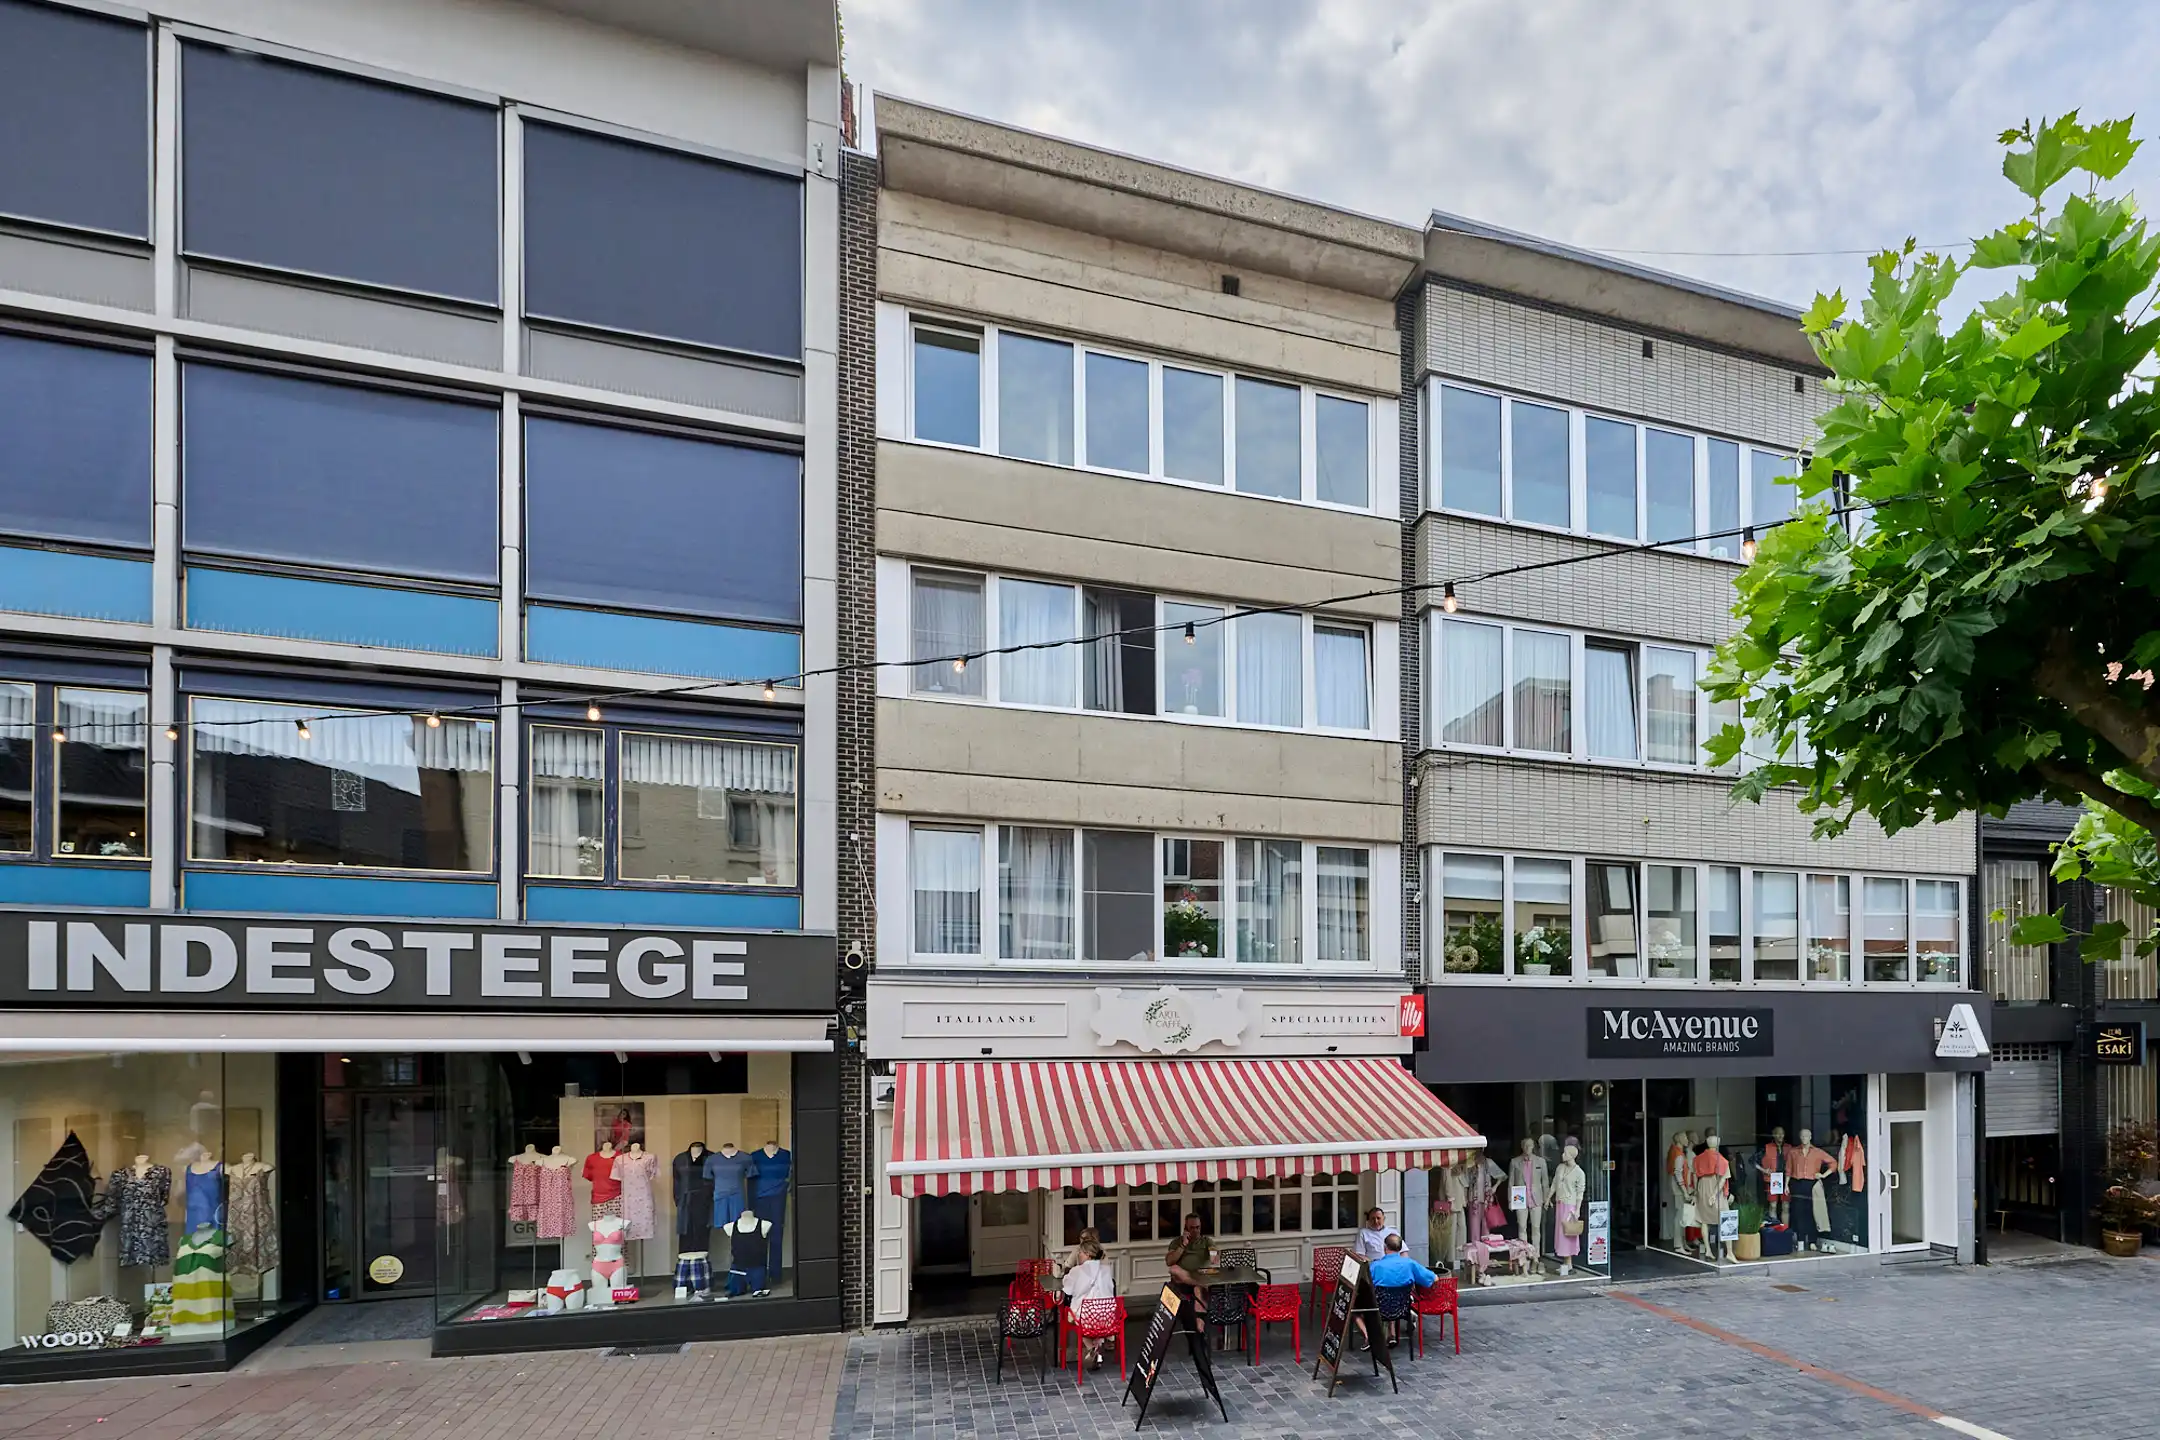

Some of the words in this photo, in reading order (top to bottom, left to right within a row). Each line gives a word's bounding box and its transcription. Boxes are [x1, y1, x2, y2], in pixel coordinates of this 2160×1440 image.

[28, 920, 748, 999] INDESTEEGE
[935, 1014, 1036, 1024] ITALIAANSE
[1271, 1015, 1388, 1024] SPECIALITEITEN
[1401, 1001, 1422, 1033] illy
[1602, 1010, 1759, 1039] McAvenue
[1662, 1041, 1702, 1053] AMAZING
[1705, 1041, 1740, 1052] BRANDS
[20, 1329, 109, 1349] WOODY
